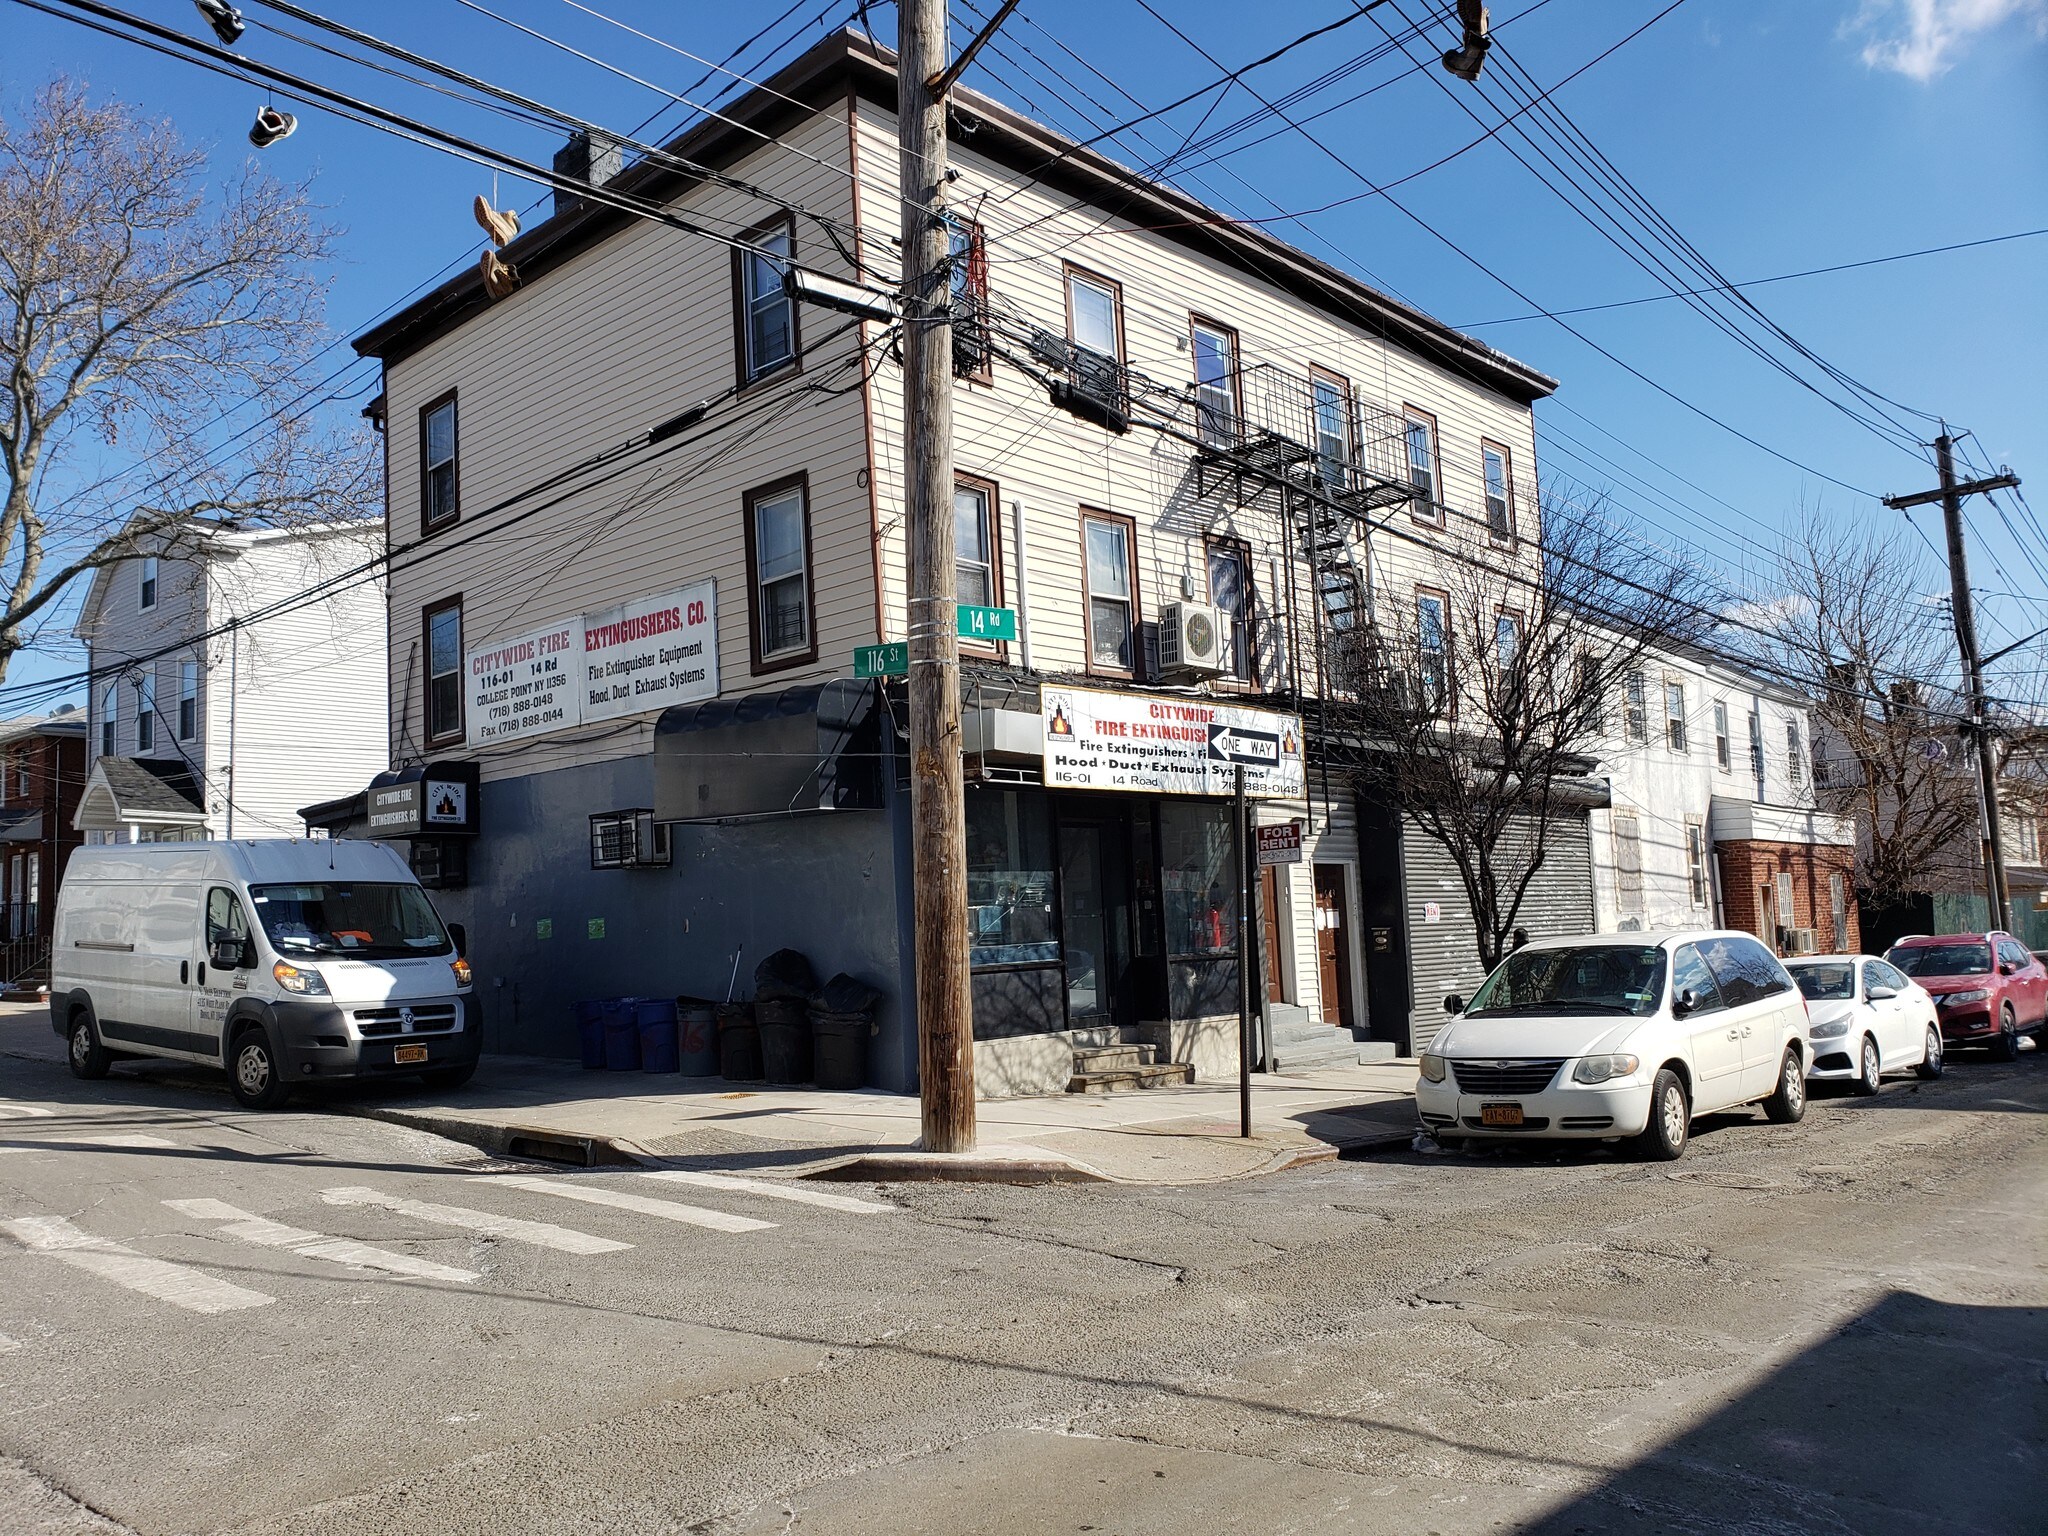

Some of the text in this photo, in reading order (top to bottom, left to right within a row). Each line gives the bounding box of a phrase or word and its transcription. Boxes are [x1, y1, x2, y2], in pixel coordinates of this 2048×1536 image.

[585, 600, 707, 652] EXTINGUISHERS, CO.
[970, 610, 1000, 633] 14 Rd
[472, 630, 570, 676] CITYWIDE FIRE
[588, 641, 703, 681] Fire Extinguisher Equipment
[868, 647, 898, 672] 116 St
[481, 658, 557, 689] 116-01 14 Rd
[476, 673, 566, 707] COLLEGE POINT NY 11356
[589, 668, 705, 705] Hood, Duct Exhaust Systems
[489, 693, 553, 721] (718) 888-0148
[1150, 704, 1215, 722] CITYWIDE
[480, 707, 563, 737] Fax (718) 888-0144
[1095, 721, 1127, 737] FIRE
[1080, 740, 1102, 752] Fire
[1107, 742, 1188, 760] Extinguishers
[1221, 736, 1272, 756] ONE WAY
[1055, 756, 1265, 779] Hood Duct Exhaust Sysms
[1055, 772, 1091, 783] 116-01
[1112, 775, 1125, 784] 14
[1130, 775, 1158, 787] Road
[377, 788, 412, 806] CITYWIDE FIRE
[432, 784, 461, 799] CITY WIDE
[409, 809, 419, 822] CO.
[1260, 837, 1297, 850] RENT
[1263, 826, 1292, 839] FOR
